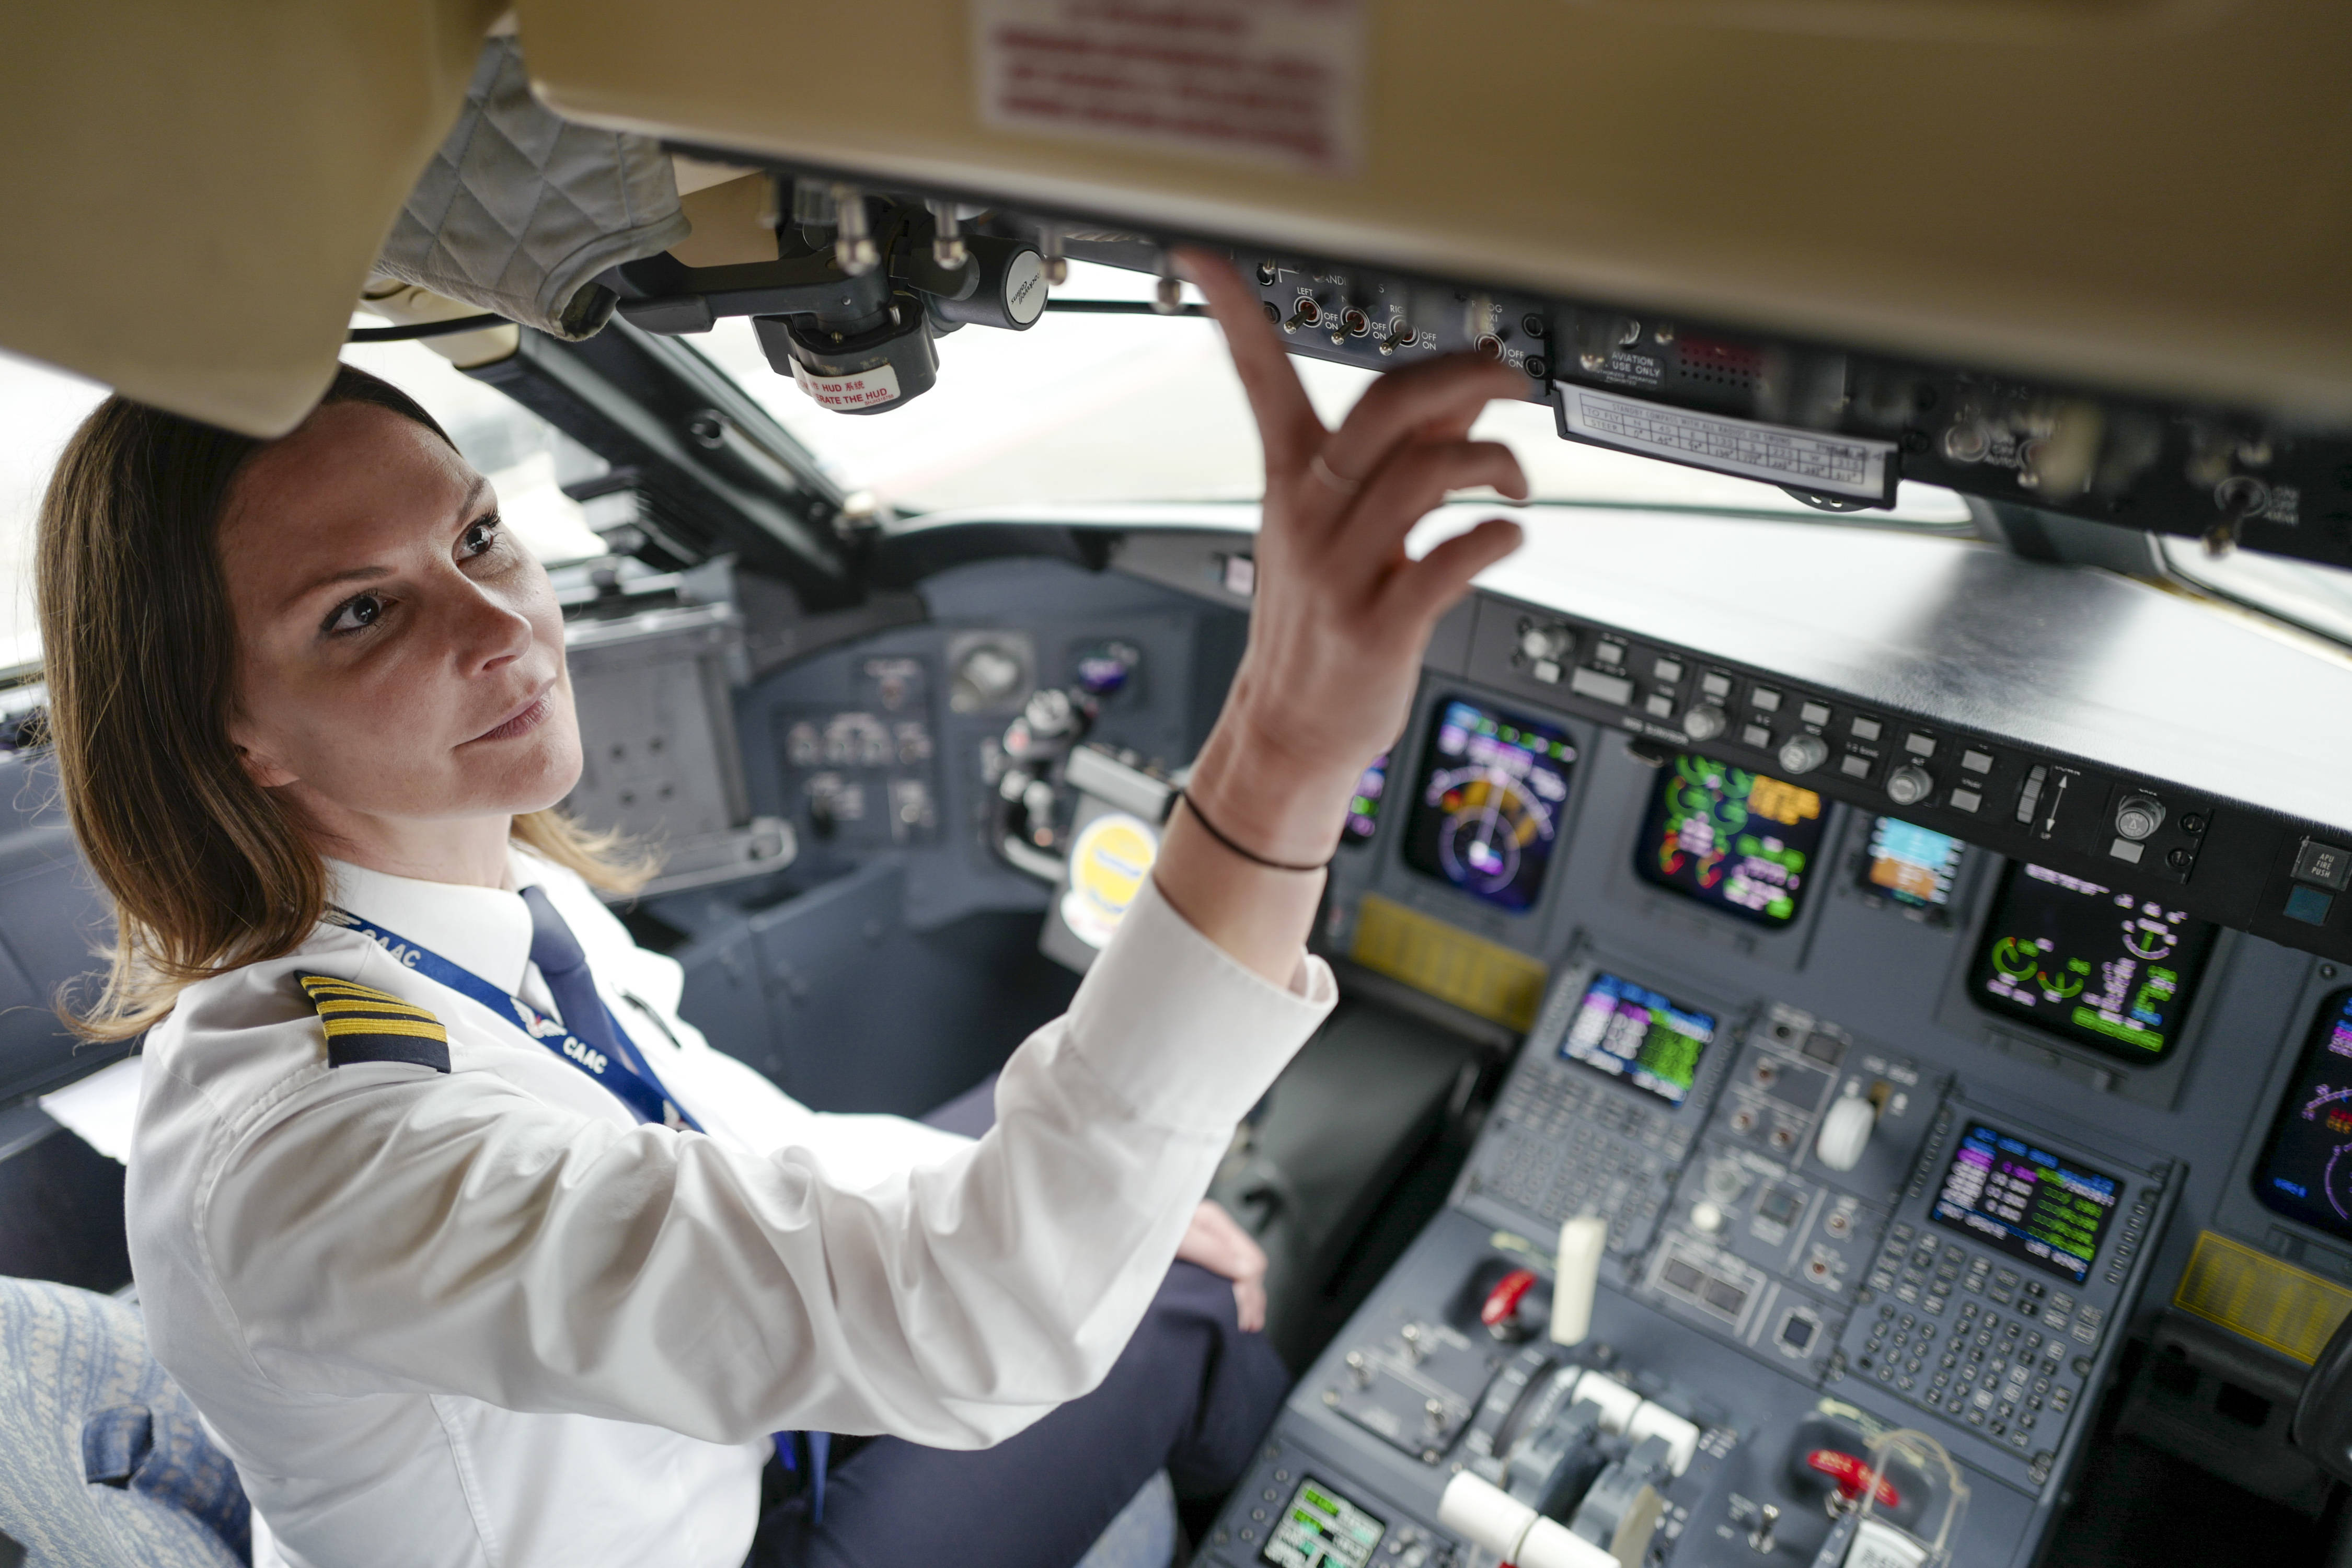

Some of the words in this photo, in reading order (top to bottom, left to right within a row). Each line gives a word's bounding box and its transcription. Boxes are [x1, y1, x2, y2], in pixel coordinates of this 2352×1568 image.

[1011, 281, 1027, 305] Collins
[1297, 286, 1313, 296] LEFT
[1390, 304, 1405, 314] RIG
[1324, 313, 1339, 321] OFF
[1325, 321, 1339, 330] ON
[1371, 322, 1387, 331] OFF
[1373, 331, 1386, 340] ON
[1421, 331, 1437, 341] OFF
[1422, 341, 1436, 351] ON
[1507, 349, 1524, 358] OFF
[1611, 351, 1654, 366] AVIATION
[1508, 359, 1524, 368] ON
[1612, 361, 1631, 373] USE
[1635, 365, 1661, 377] ONLY
[822, 384, 842, 393] HUD
[845, 380, 865, 392] 系统
[843, 394, 863, 405] THE
[865, 388, 887, 400] HUD
[1587, 408, 1599, 417] TO
[1604, 412, 1619, 421] FLY
[1590, 419, 1617, 431] STEER
[2319, 853, 2335, 863] APU
[2316, 860, 2332, 870] FIRE
[2311, 867, 2331, 878] PUSH
[562, 1036, 608, 1075] CAAC
